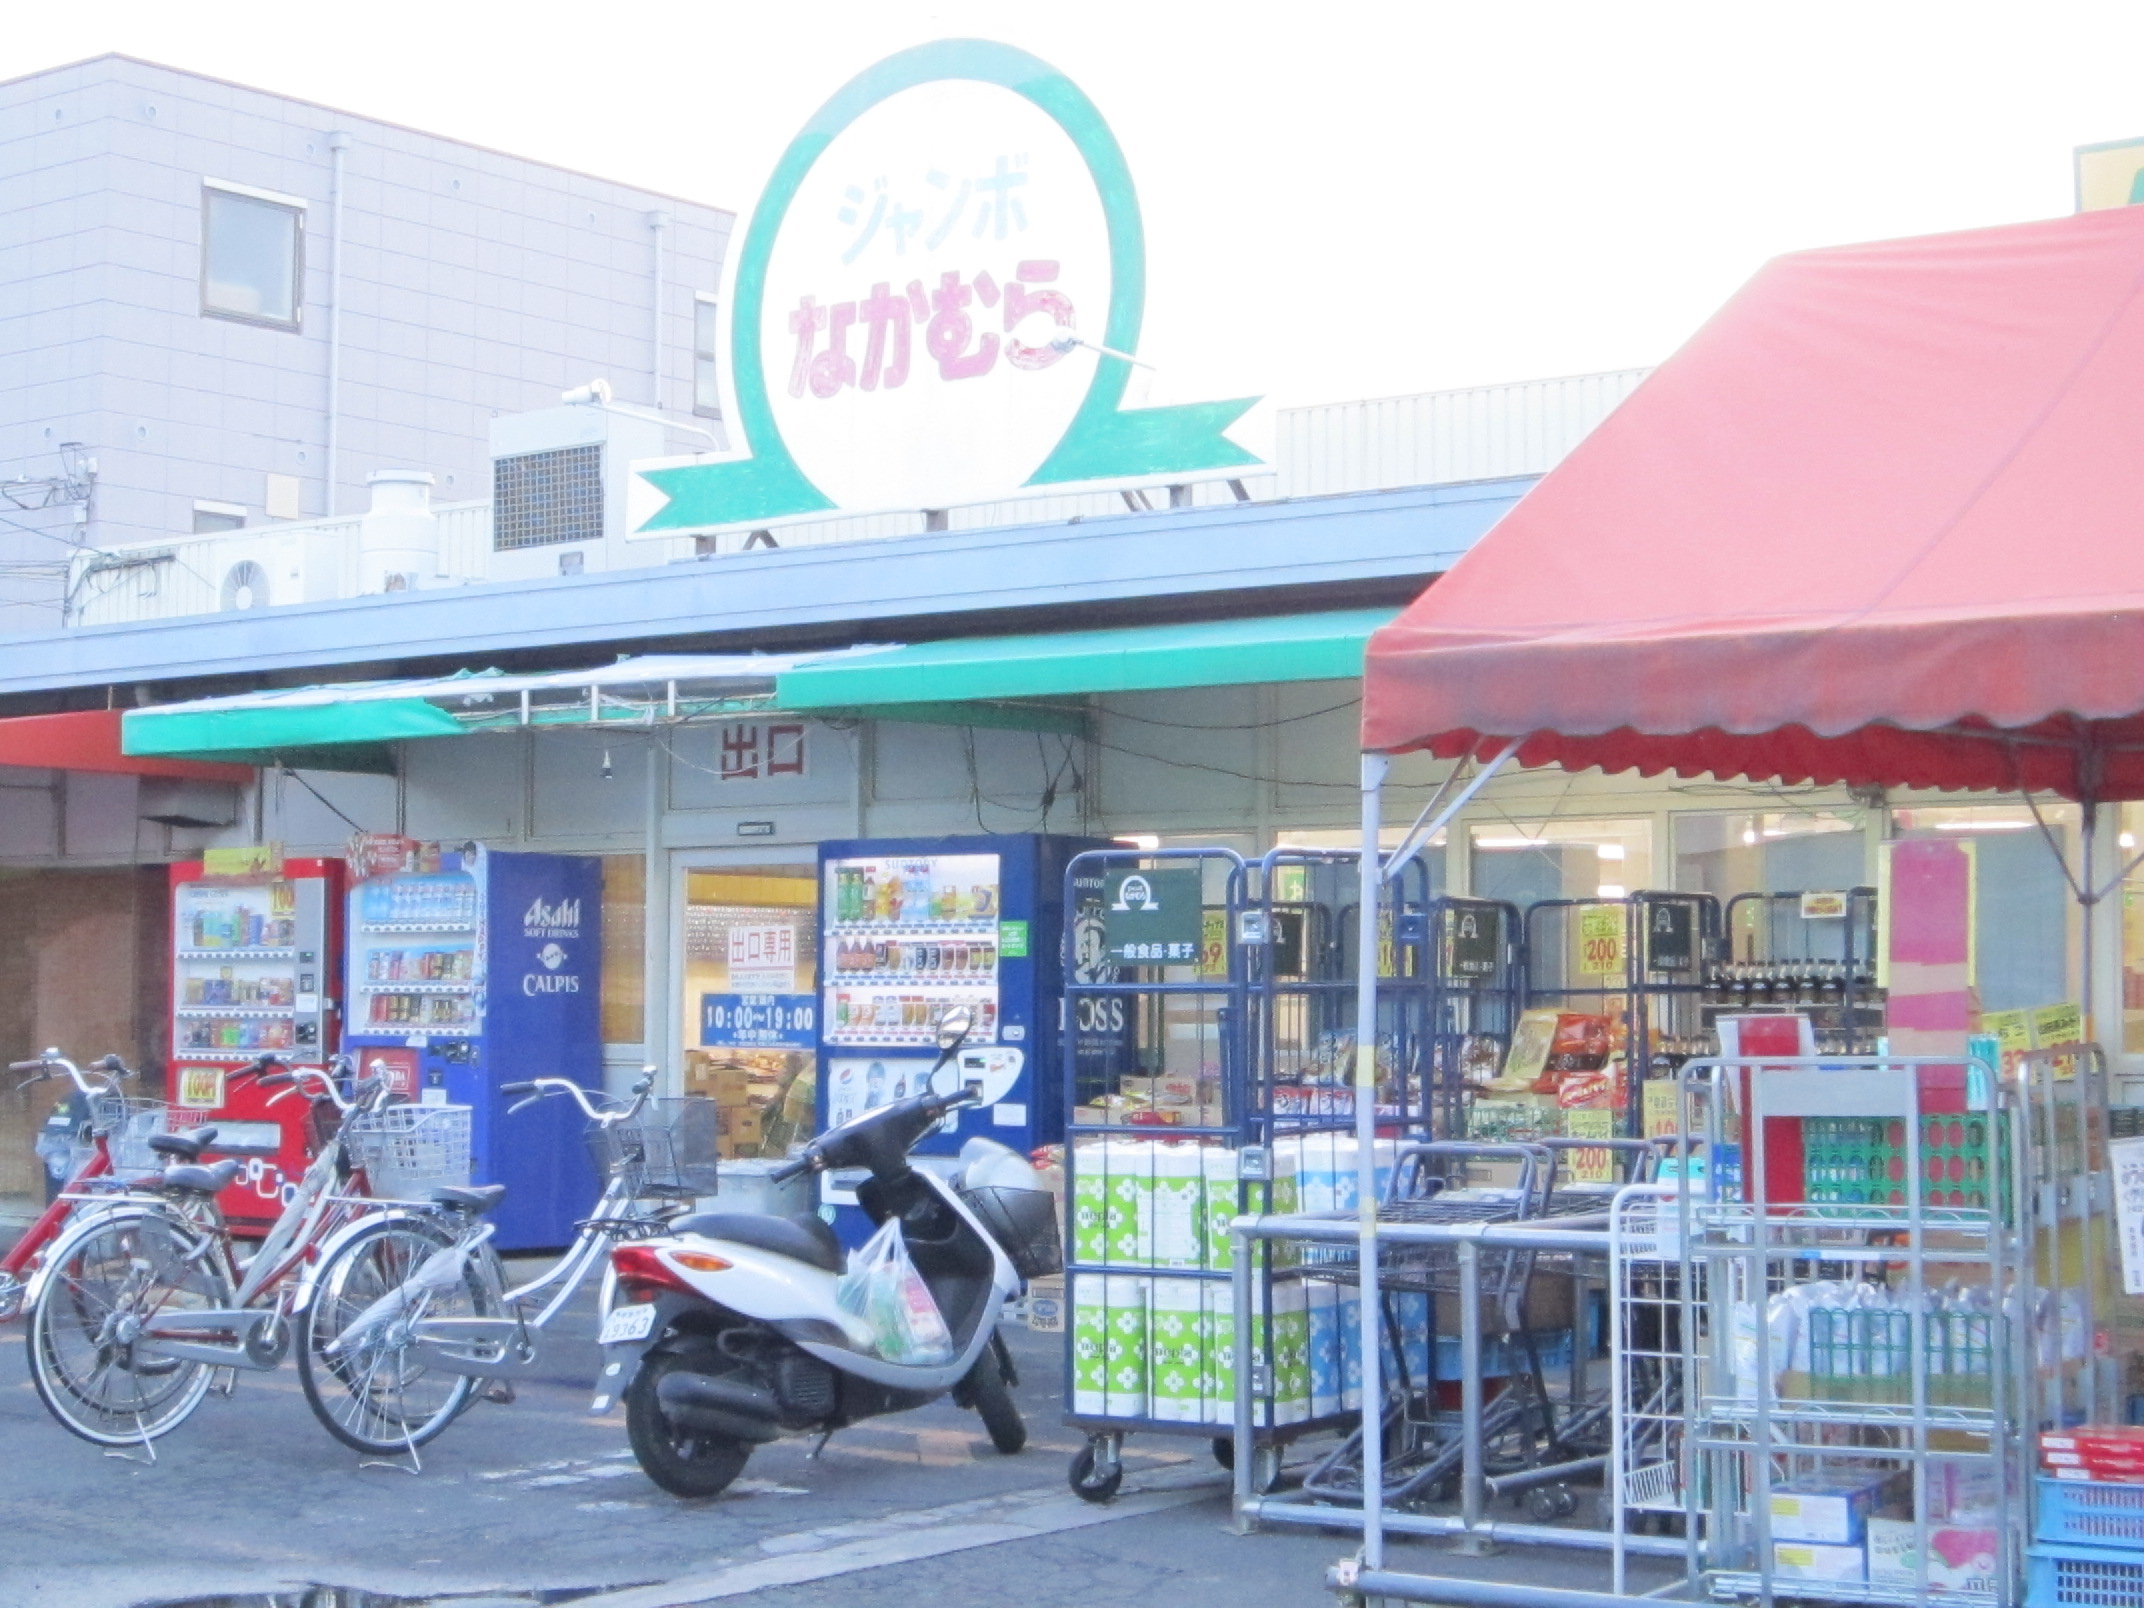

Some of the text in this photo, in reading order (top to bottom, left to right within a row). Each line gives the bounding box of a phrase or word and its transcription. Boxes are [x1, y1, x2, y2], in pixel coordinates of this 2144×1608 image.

[837, 152, 1029, 267] ジャンボ
[787, 259, 1077, 399] なかむら
[721, 723, 804, 780] 出口
[523, 897, 580, 928] Asahi
[731, 928, 791, 963] 出口専用
[1587, 938, 1616, 961] 200
[523, 974, 579, 996] CALPIS
[1577, 1147, 1606, 1170] 200
